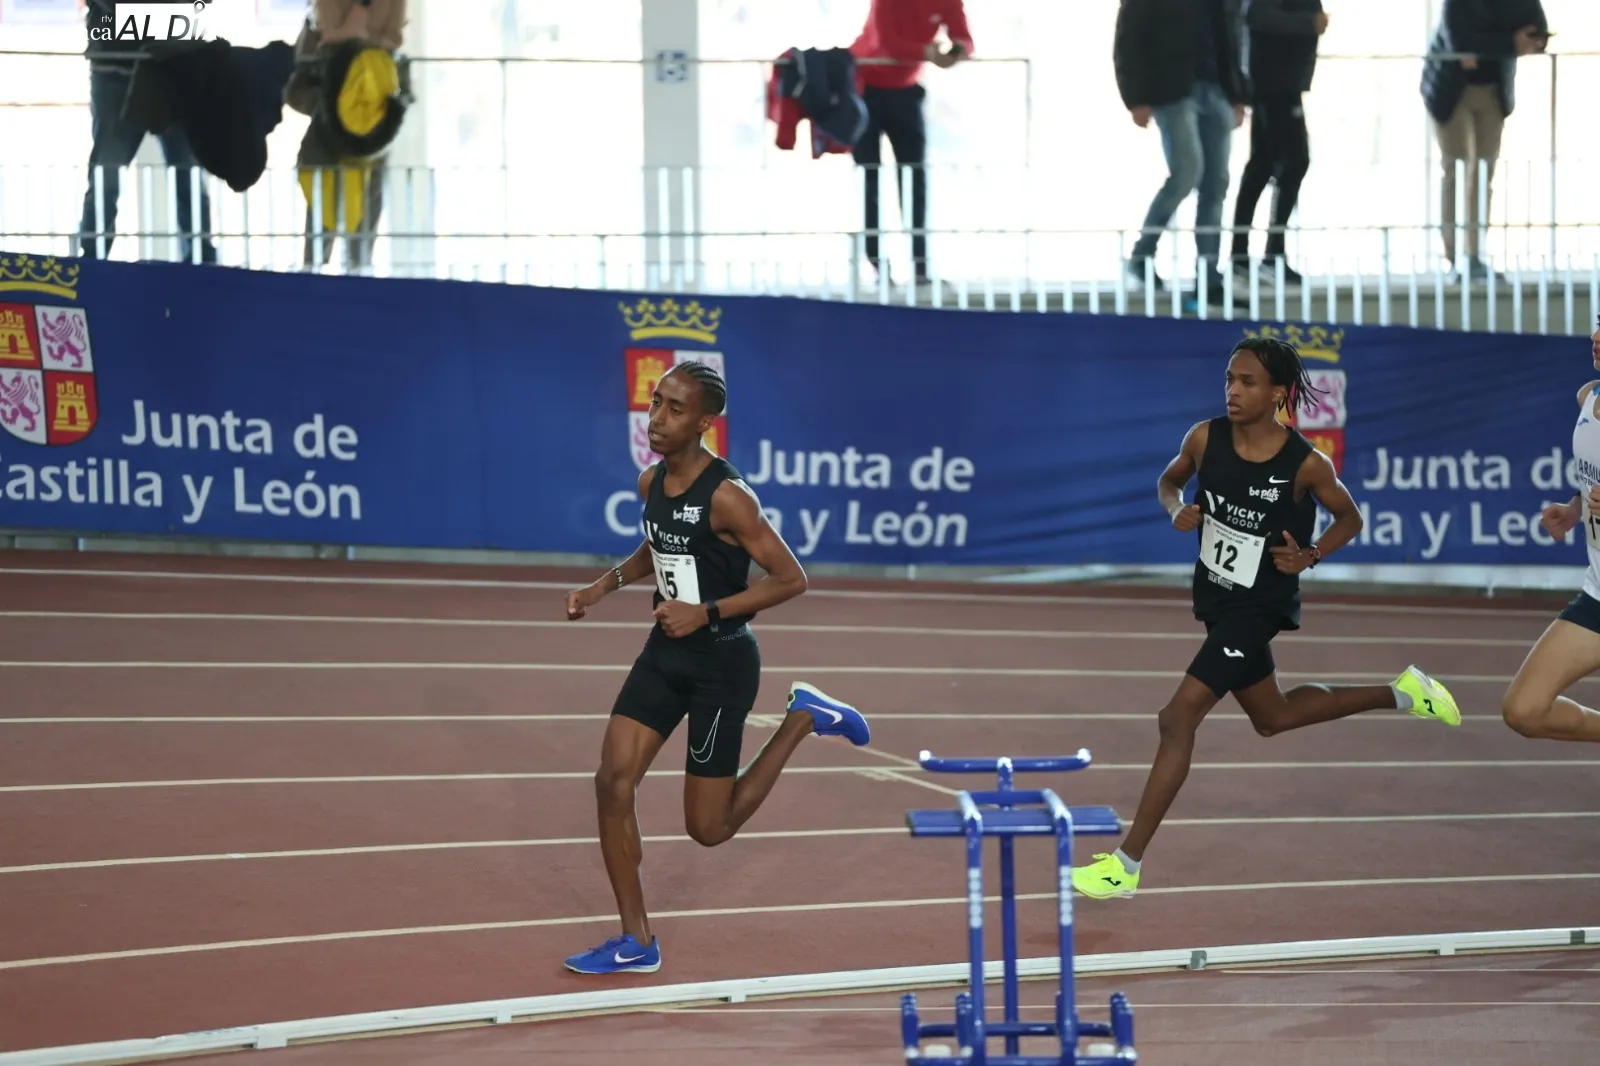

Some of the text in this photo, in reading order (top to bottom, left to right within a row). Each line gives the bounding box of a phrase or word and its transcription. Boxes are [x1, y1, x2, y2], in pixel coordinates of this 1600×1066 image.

[122, 400, 358, 460] Junta de
[747, 439, 974, 491] Junta de
[1363, 447, 1511, 490] Junta
[0, 457, 361, 524] astilla y León
[797, 508, 830, 555] y
[845, 500, 969, 548] León
[1226, 503, 1266, 522] VICKY
[1226, 515, 1259, 530] FOODS
[658, 530, 690, 546] VICKY
[662, 542, 689, 553] FOODS
[1420, 510, 1452, 560] y
[1213, 539, 1238, 573] 12
[660, 567, 678, 599] 15
